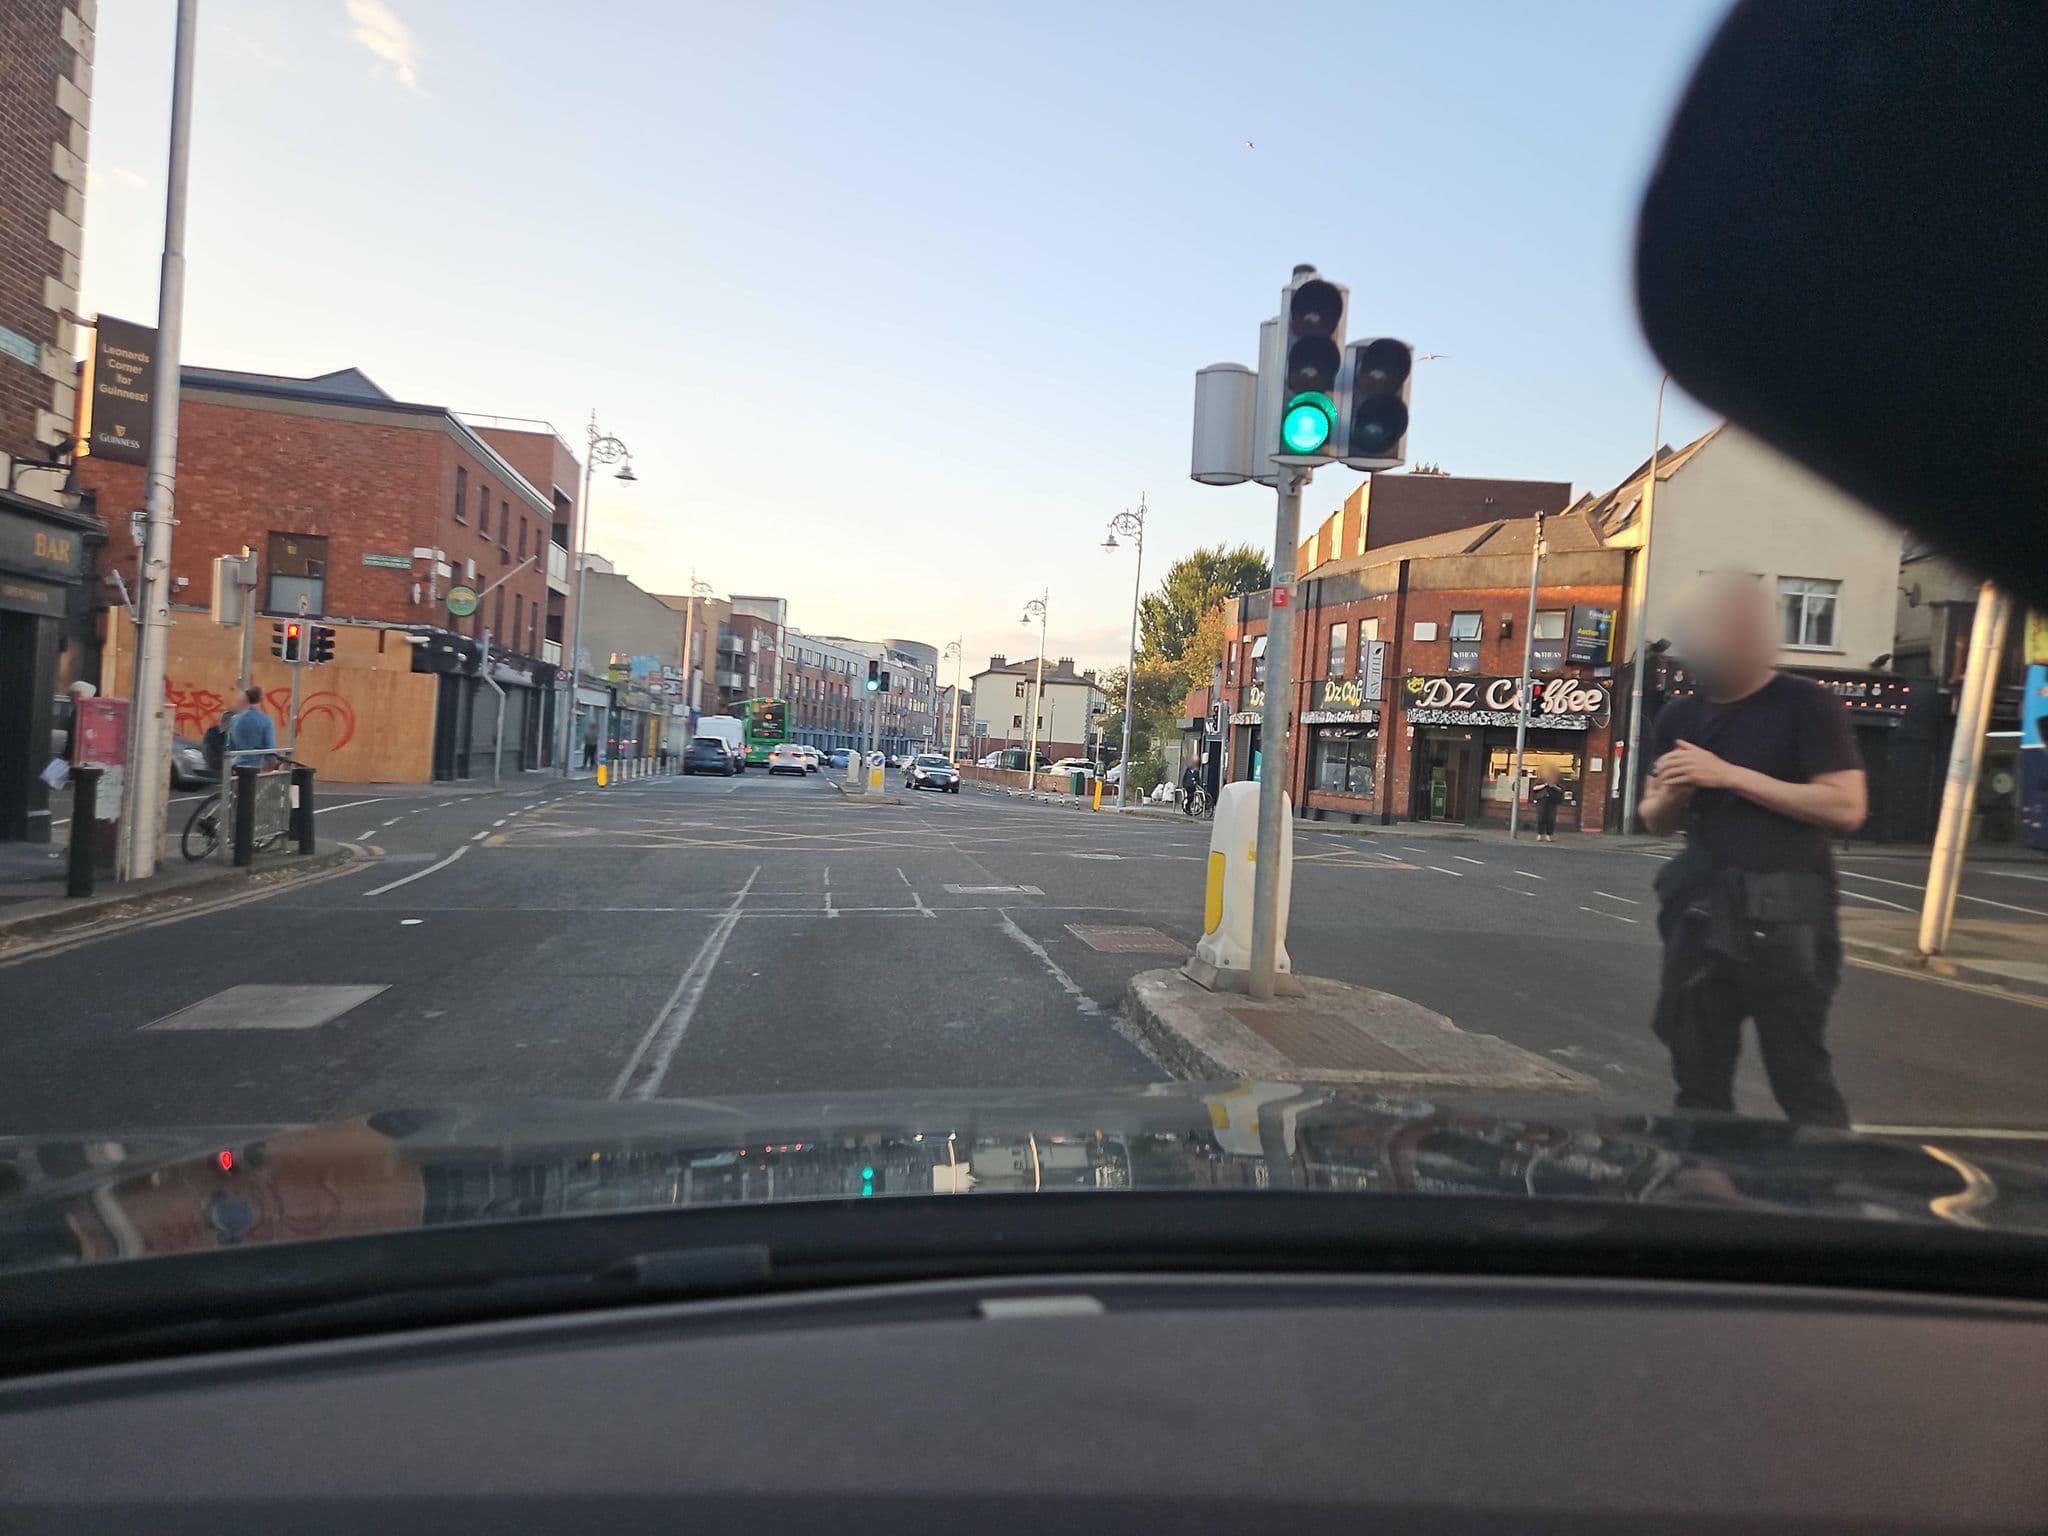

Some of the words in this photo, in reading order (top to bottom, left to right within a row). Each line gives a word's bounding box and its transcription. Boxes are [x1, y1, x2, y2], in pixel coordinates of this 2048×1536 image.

[103, 344, 150, 363] Leonards
[108, 359, 143, 375] Corner
[116, 373, 133, 386] for
[99, 383, 149, 402] Guinness!
[99, 433, 141, 449] GUINNESS
[34, 531, 70, 563] BAR
